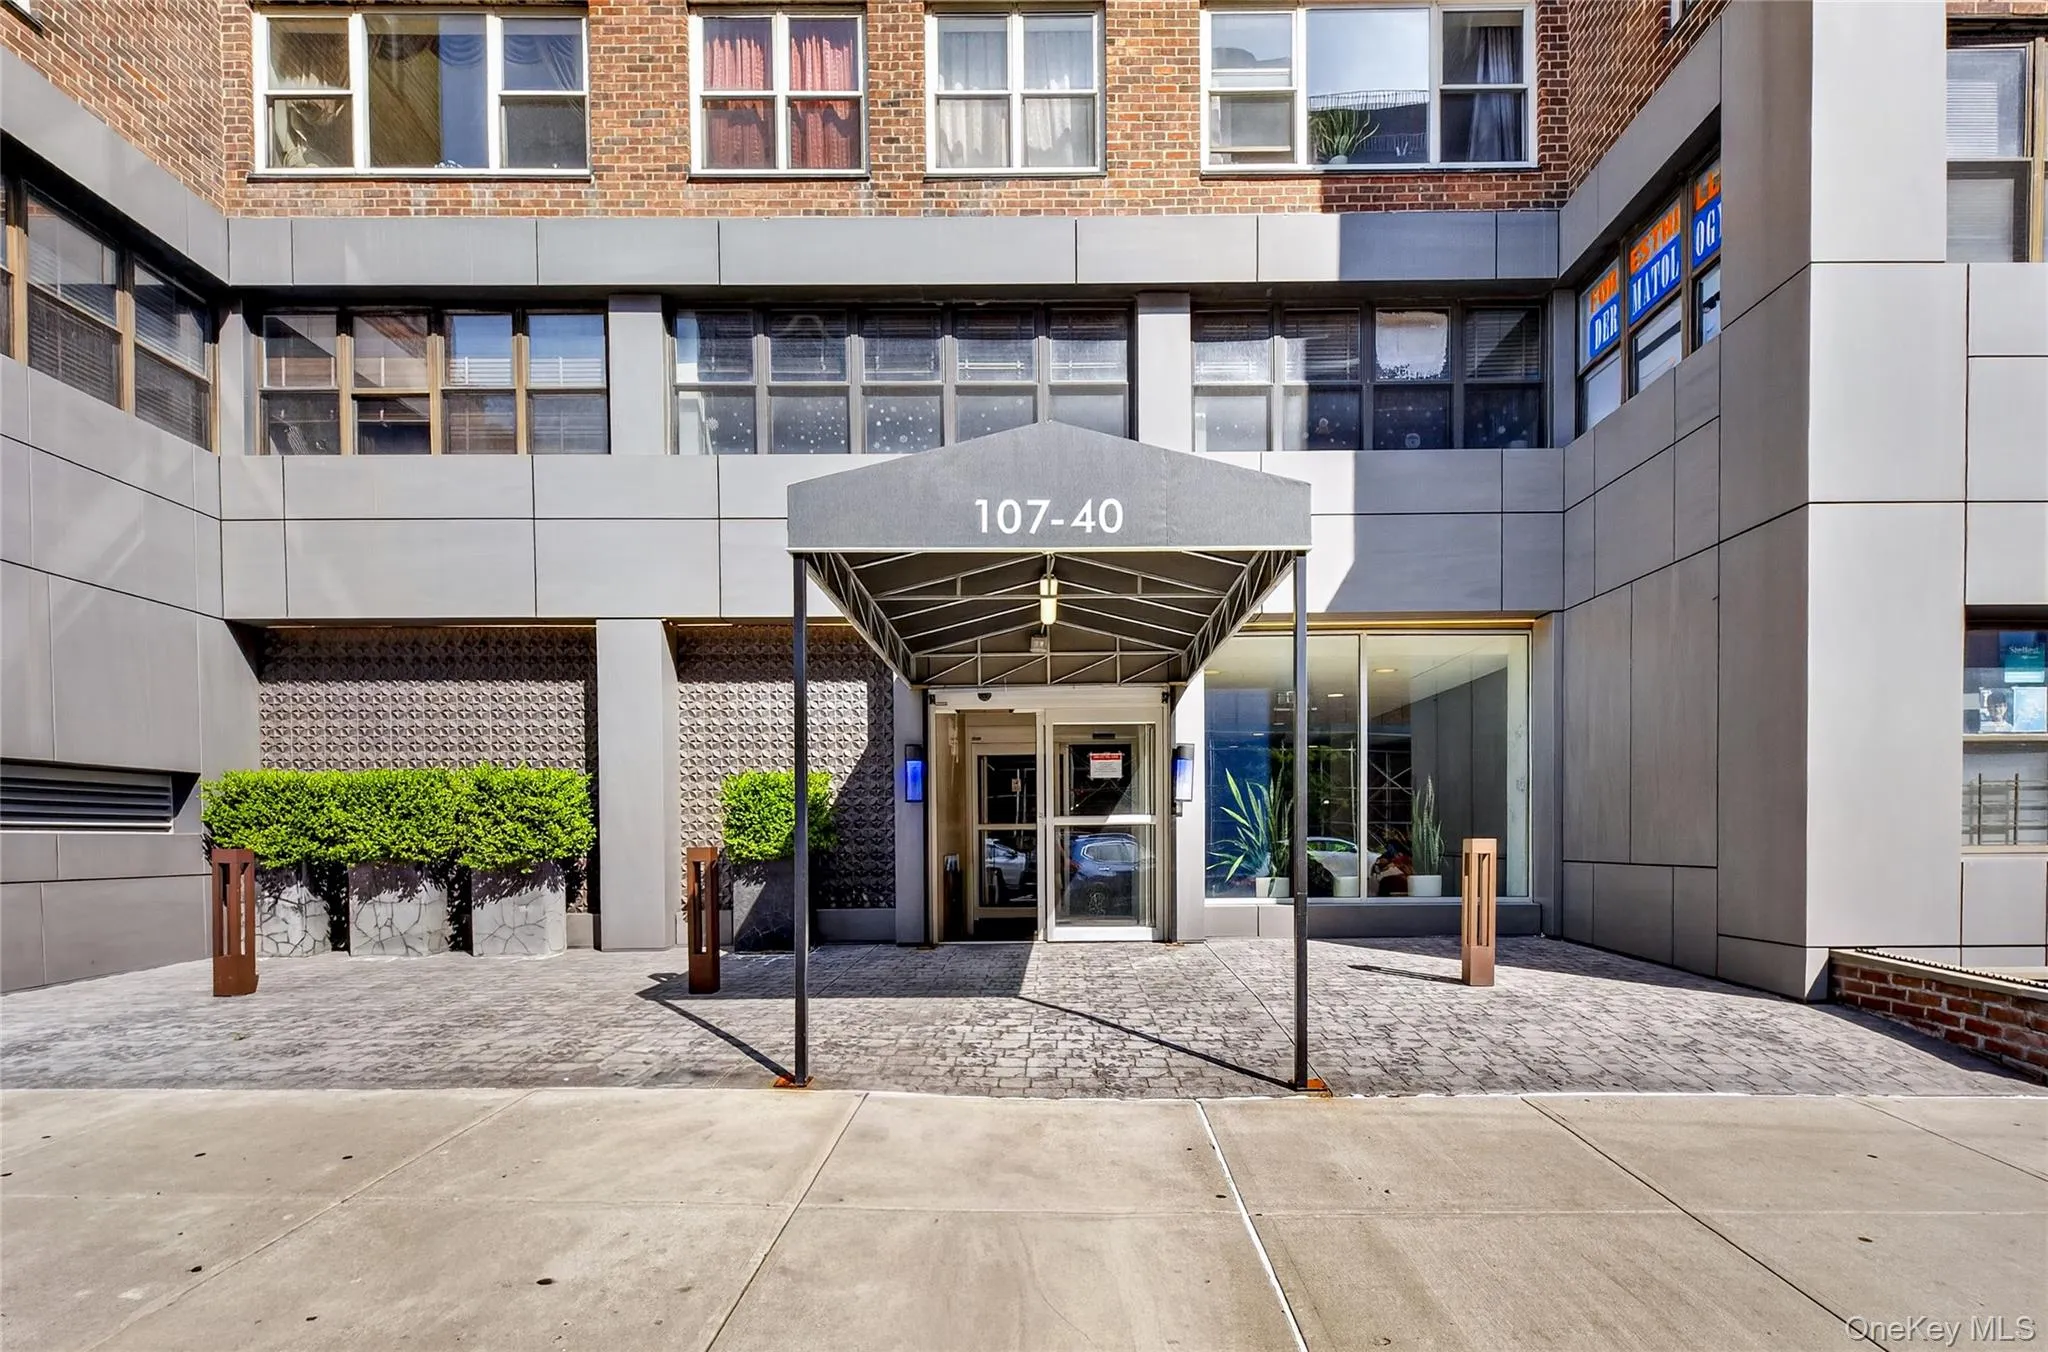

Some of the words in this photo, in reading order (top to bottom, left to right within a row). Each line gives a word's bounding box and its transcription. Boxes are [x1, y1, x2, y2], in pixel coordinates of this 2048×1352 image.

[1594, 303, 1618, 350] DER
[1632, 244, 1680, 316] MATOL
[975, 498, 1124, 535] 107-40
